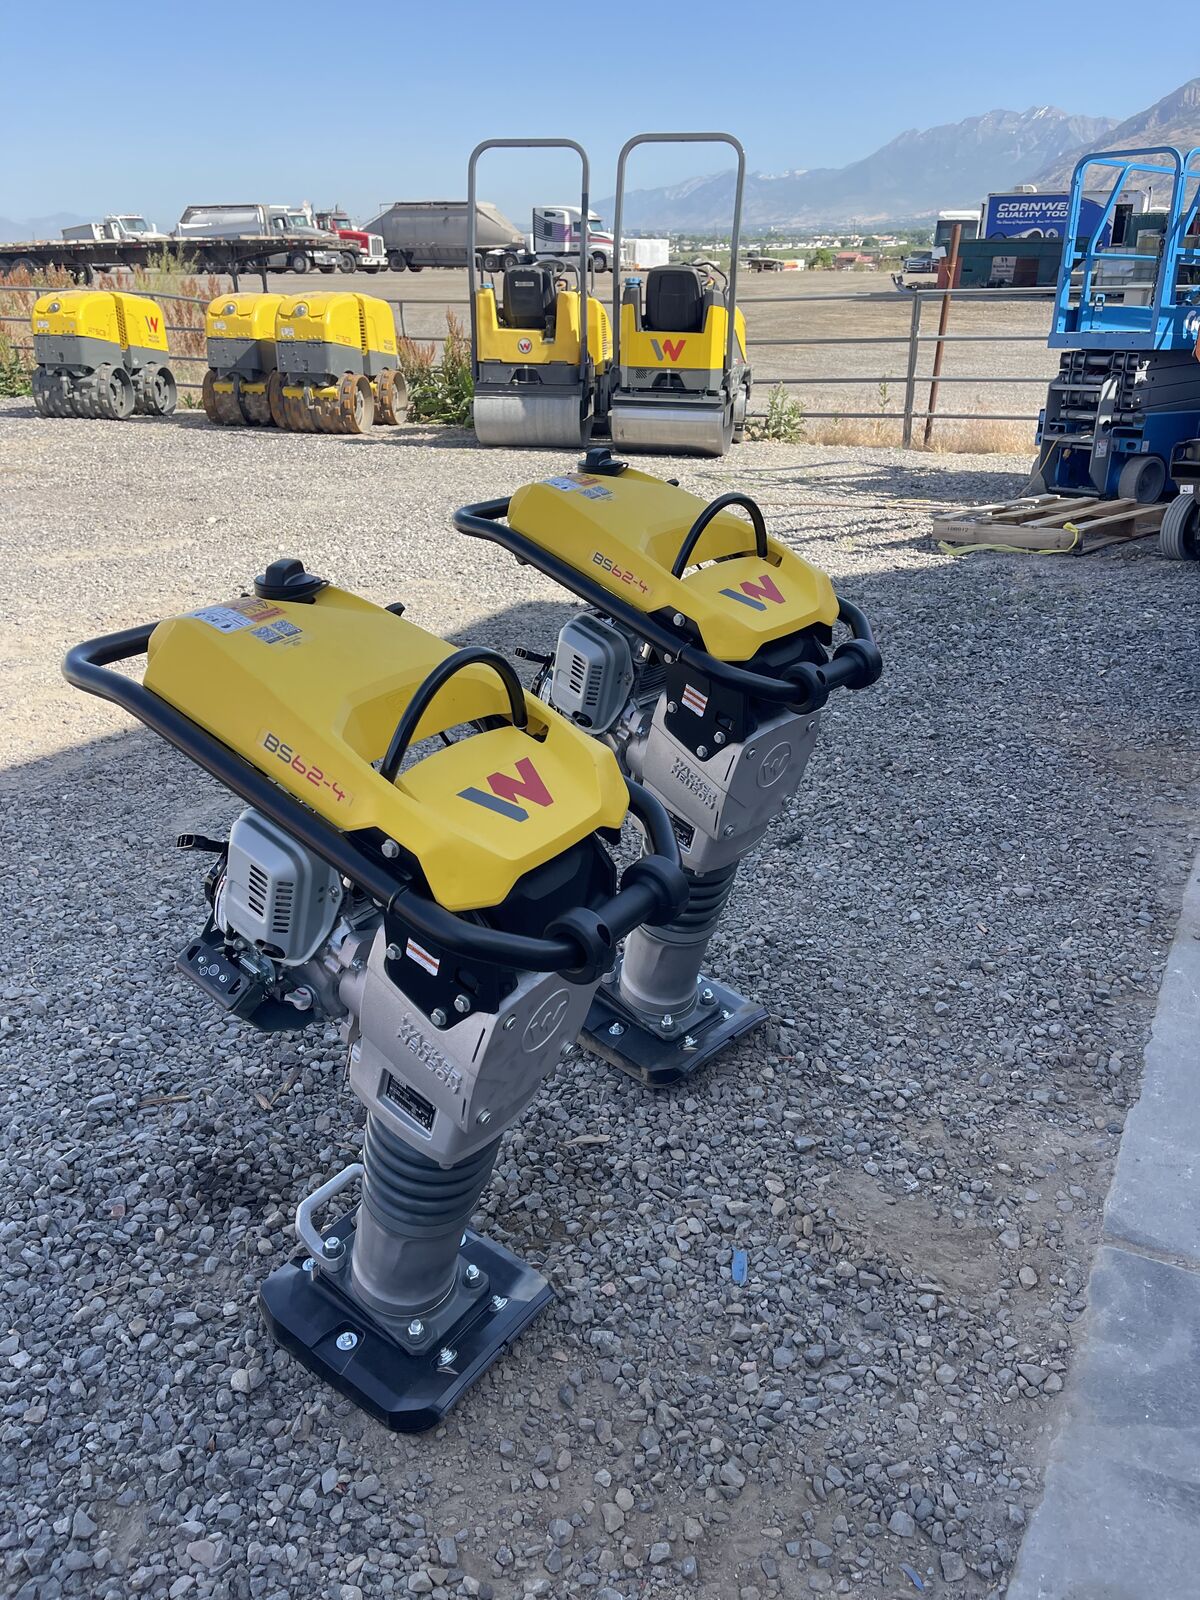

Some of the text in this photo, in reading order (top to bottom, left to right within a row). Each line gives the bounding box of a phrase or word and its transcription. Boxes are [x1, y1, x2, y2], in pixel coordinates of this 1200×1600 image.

[1046, 210, 1068, 218] TOO
[650, 338, 687, 362] W
[592, 551, 649, 594] BS62-4
[717, 574, 786, 612] W
[263, 733, 346, 802] BS62-4
[456, 756, 554, 823] W
[671, 763, 716, 809] NEUSON
[674, 755, 718, 801] WACKER
[397, 1028, 461, 1095] NEUSON
[400, 1011, 464, 1083] WACKER
